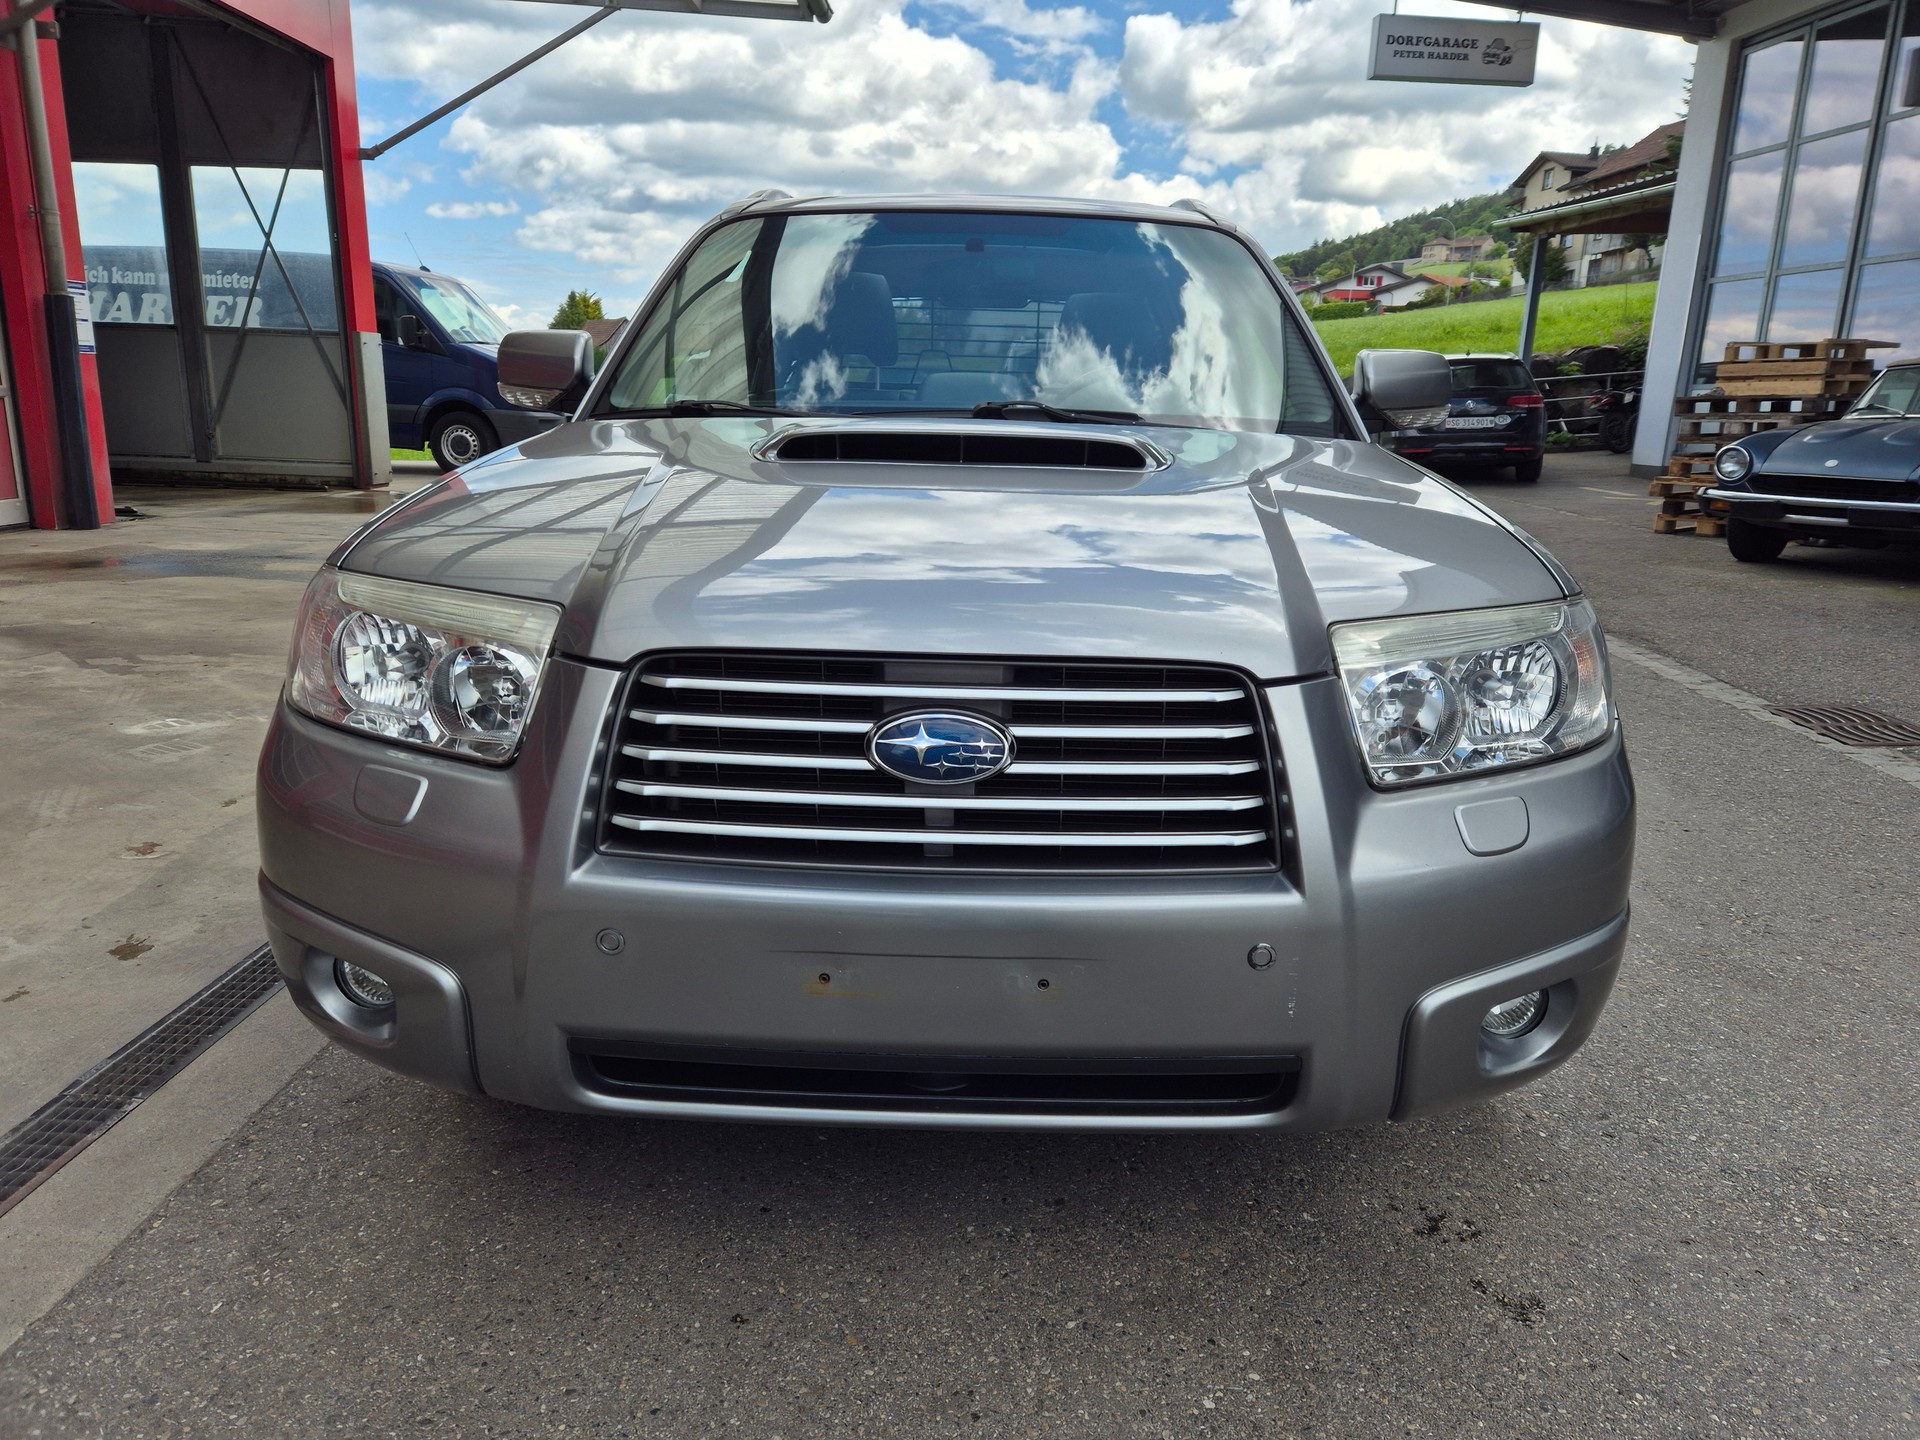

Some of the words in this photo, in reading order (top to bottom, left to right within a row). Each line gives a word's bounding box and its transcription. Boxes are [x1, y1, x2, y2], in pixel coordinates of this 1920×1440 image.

[1386, 34, 1479, 49] DORFGARAGE
[1393, 50, 1425, 59] PETER
[1427, 51, 1470, 61] HARDER
[111, 266, 155, 285] kann
[202, 270, 261, 290] mieten
[1498, 416, 1508, 424] CH
